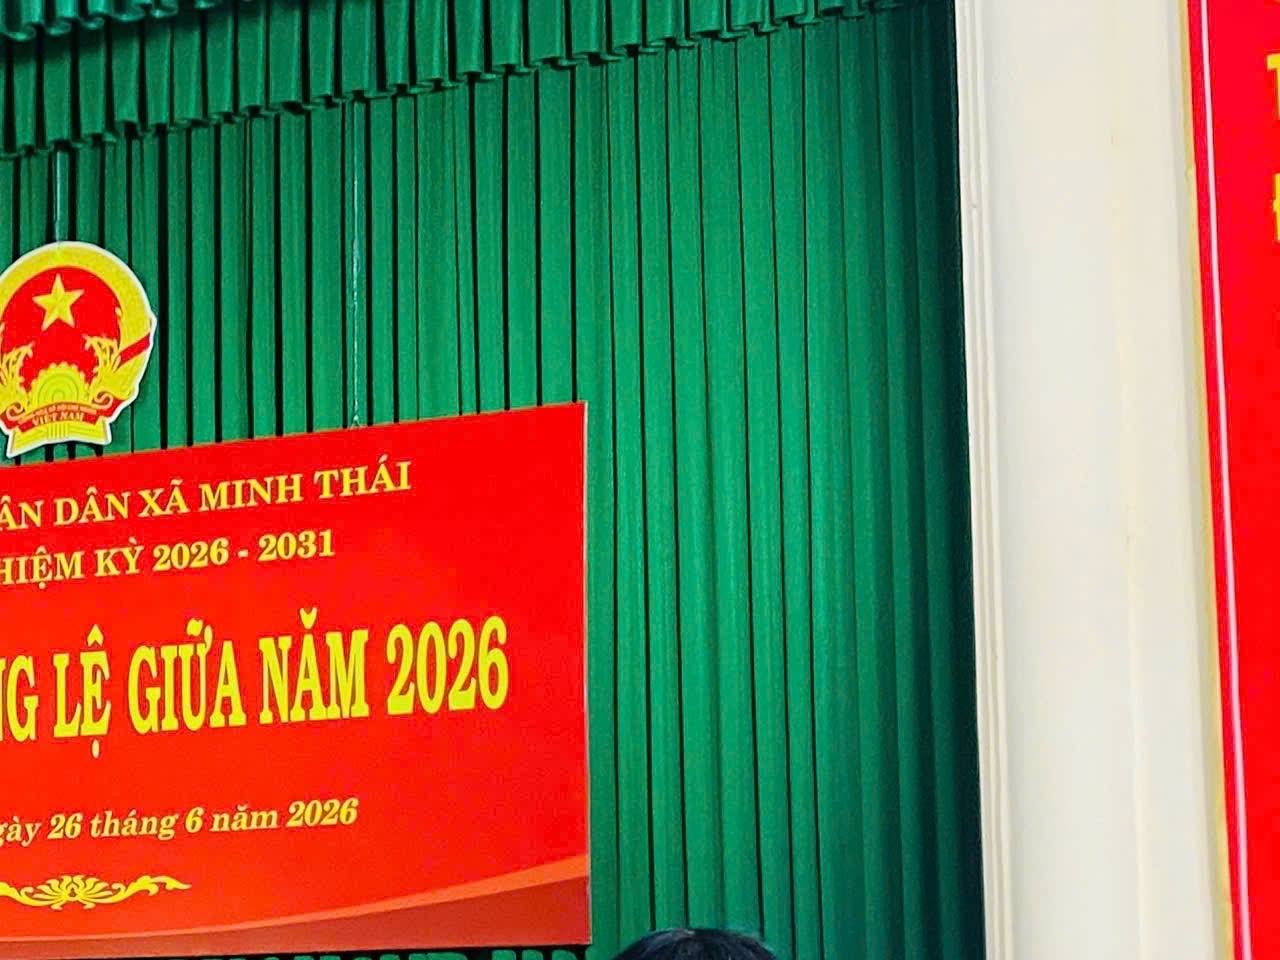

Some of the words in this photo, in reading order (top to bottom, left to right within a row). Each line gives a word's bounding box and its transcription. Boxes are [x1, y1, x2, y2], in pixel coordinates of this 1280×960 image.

[54, 486, 131, 526] DÂN
[138, 479, 190, 517] XÃ
[199, 473, 303, 512] MINH
[313, 454, 411, 499] THÁI
[94, 536, 144, 577] KỲ
[153, 537, 229, 571] 2026
[237, 549, 249, 558] -
[258, 529, 335, 562] 2031
[53, 624, 112, 758] LỆ
[127, 618, 247, 735] GIỮA
[258, 607, 370, 725] NĂM
[386, 615, 509, 716] 2026
[47, 812, 83, 839] 26
[90, 809, 179, 841] tháng
[185, 806, 205, 833] 6
[210, 804, 278, 832] năm
[285, 797, 359, 827] 2026
